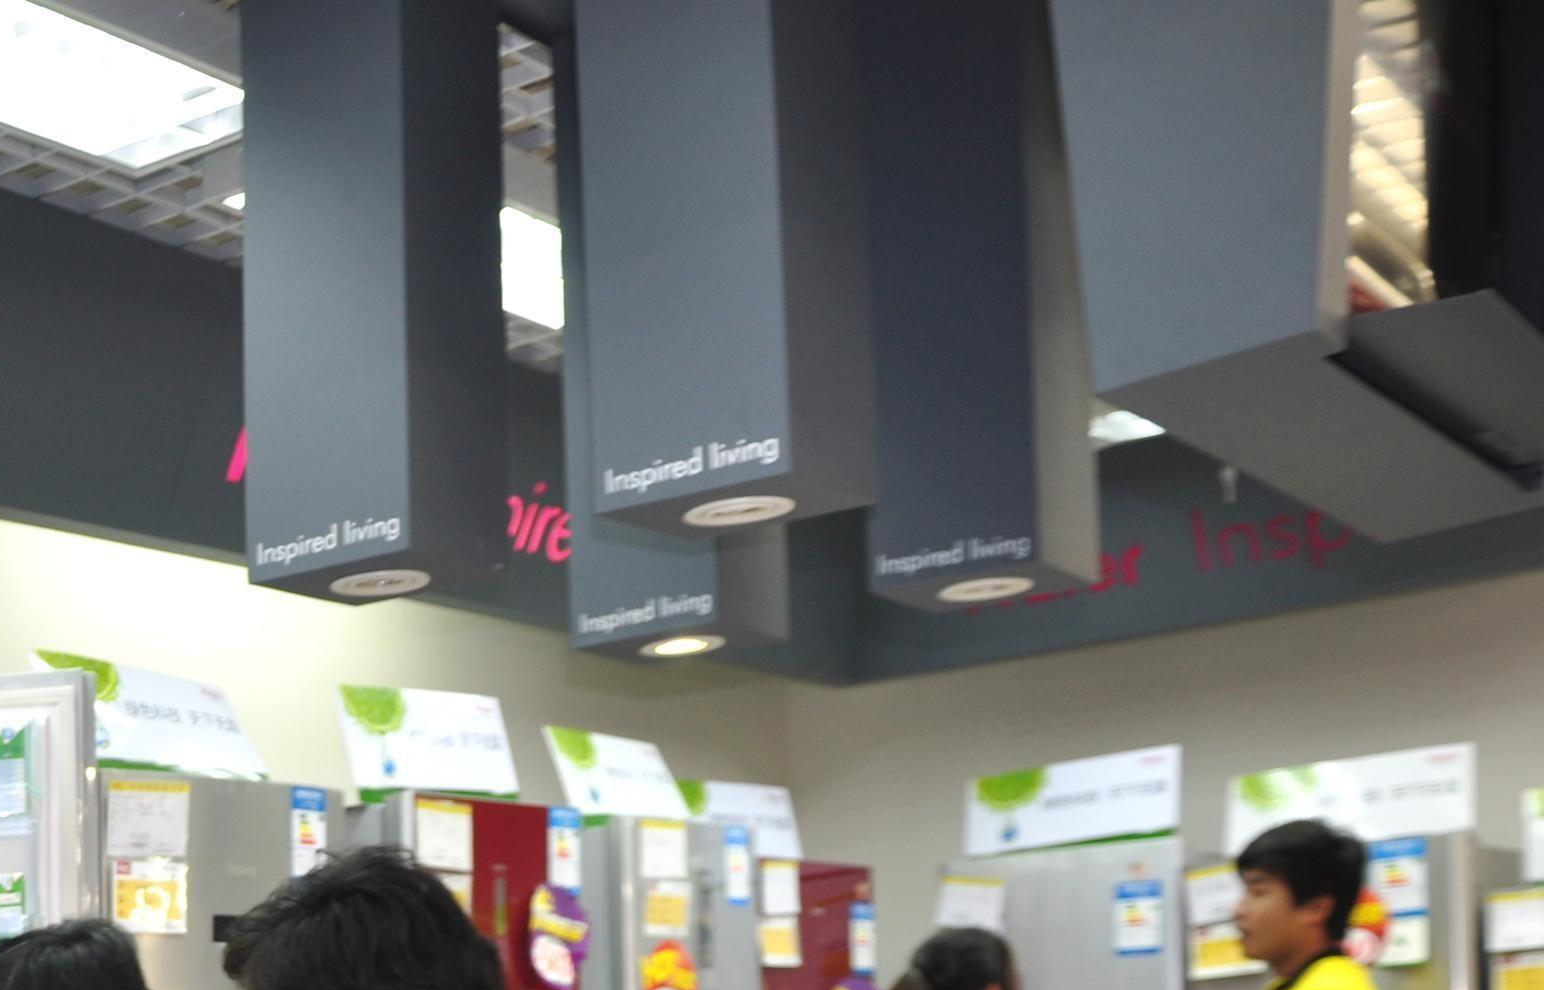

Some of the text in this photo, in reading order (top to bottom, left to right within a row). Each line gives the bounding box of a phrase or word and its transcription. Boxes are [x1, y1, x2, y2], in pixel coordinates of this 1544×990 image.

[604, 437, 780, 494] Inspired living
[257, 517, 401, 565] Inspired living
[875, 536, 1031, 576] Inspired living
[577, 593, 714, 635] Inspired living
